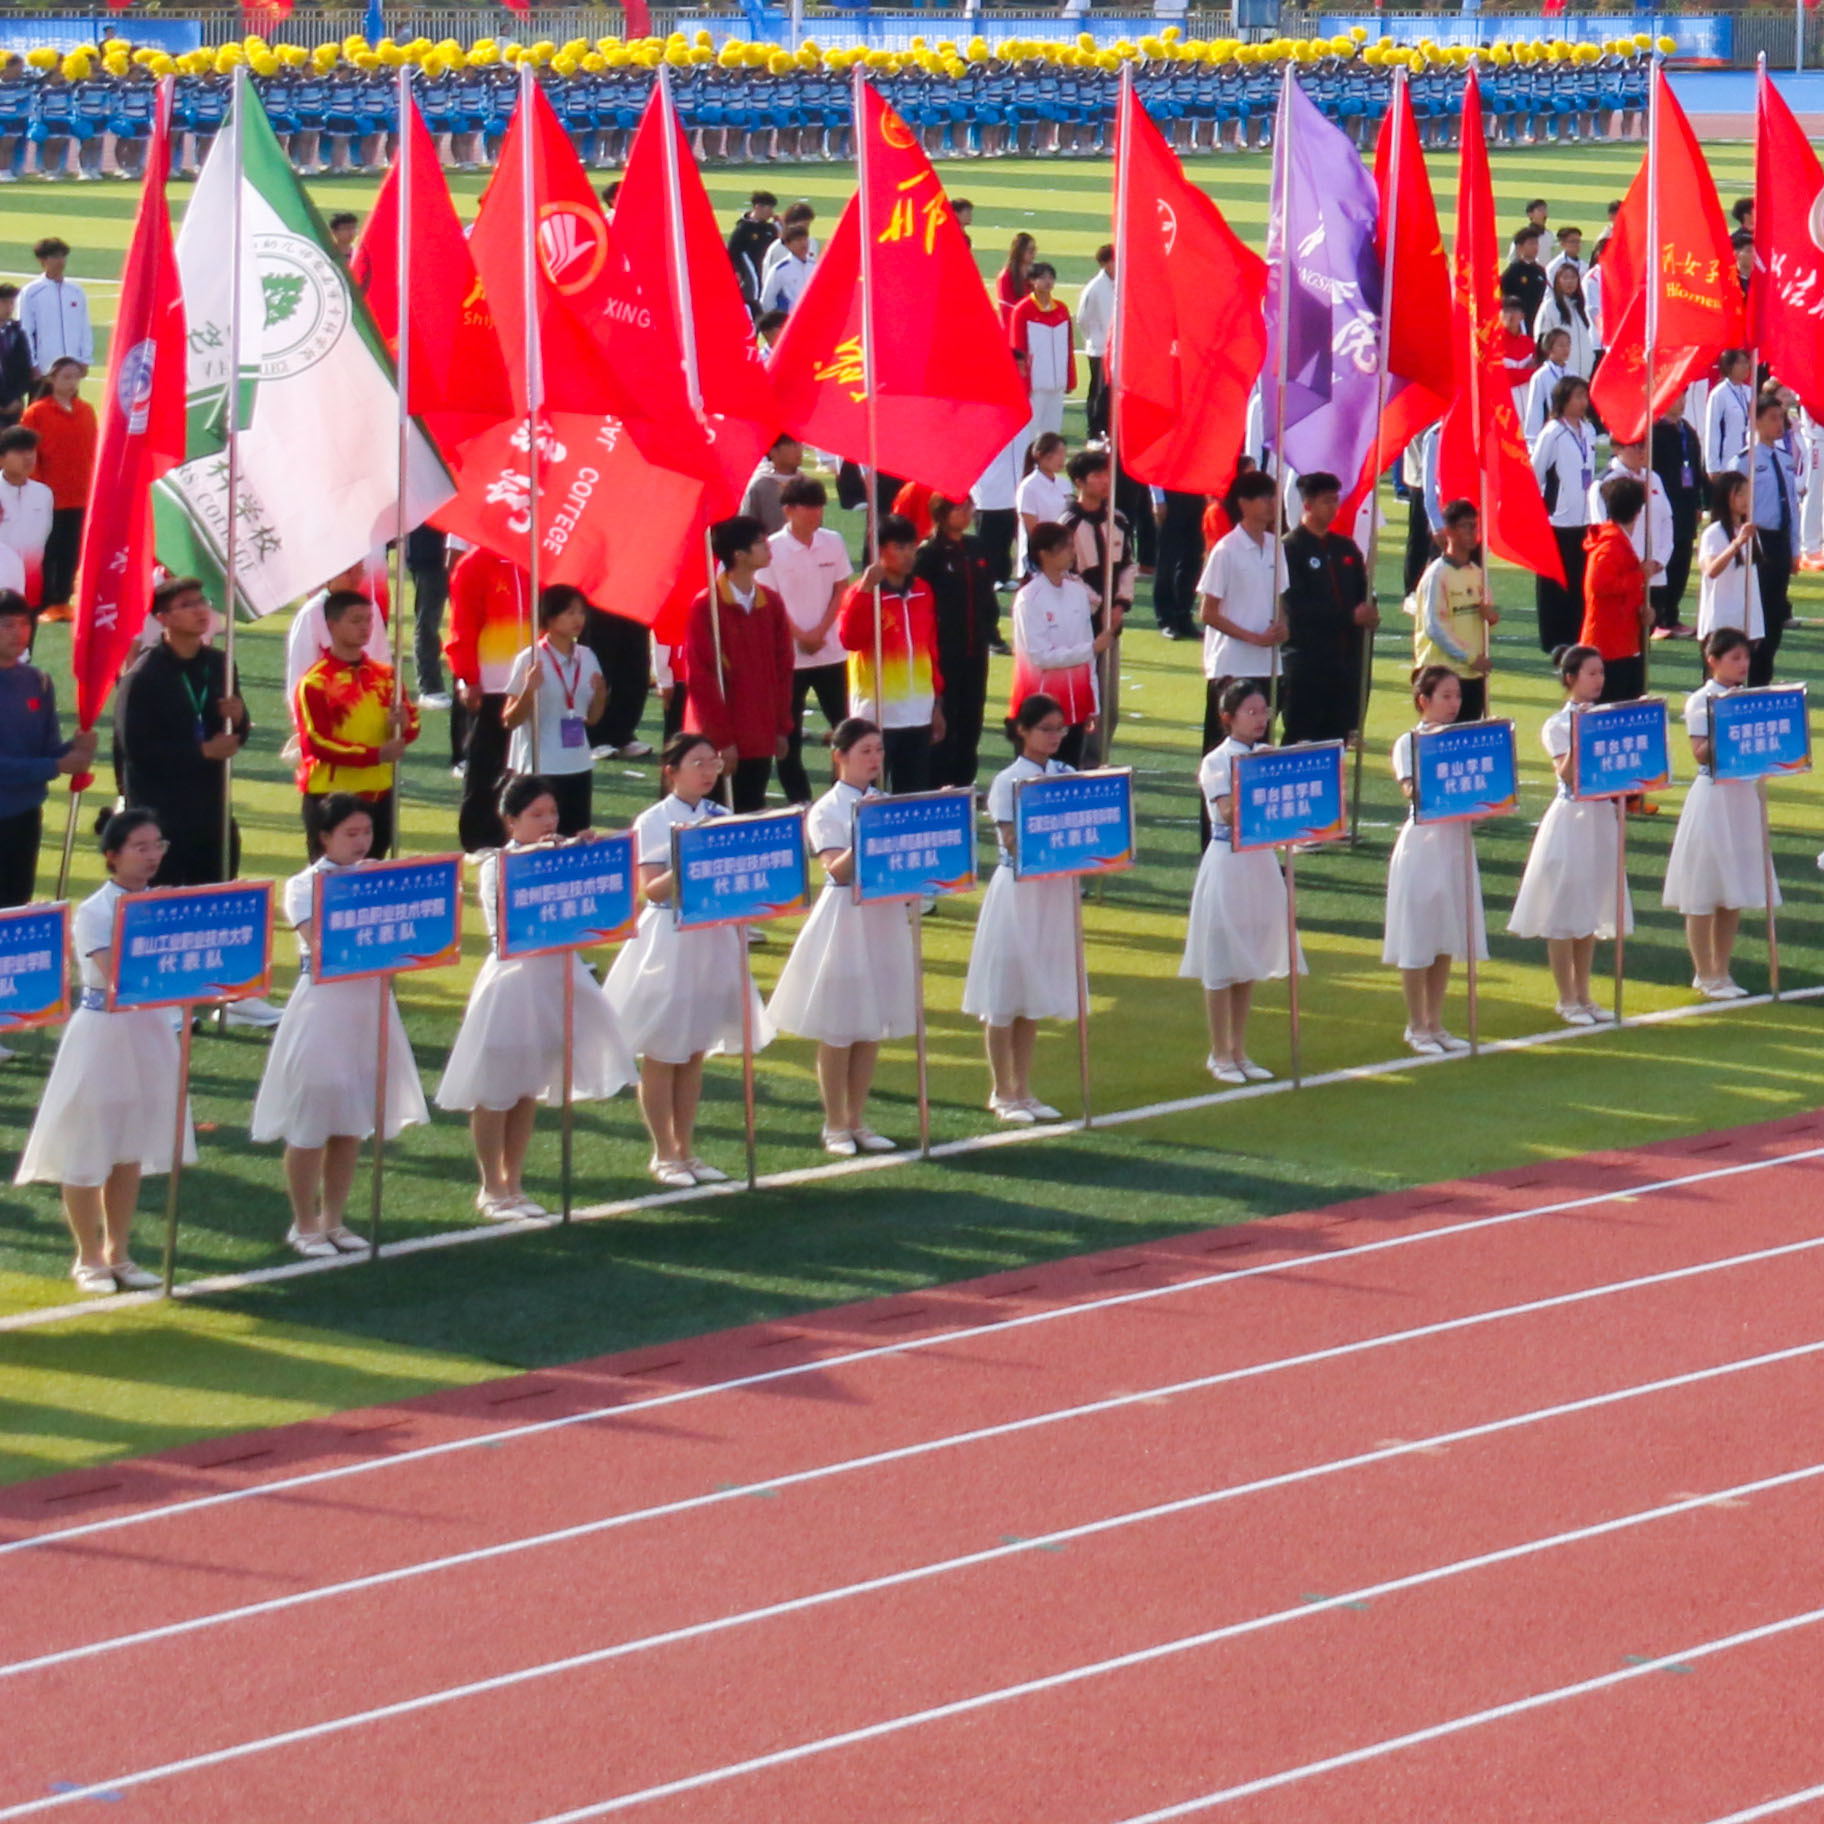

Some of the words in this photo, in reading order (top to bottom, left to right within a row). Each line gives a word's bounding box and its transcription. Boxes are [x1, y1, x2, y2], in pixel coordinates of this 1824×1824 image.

[1727, 718, 1792, 740] 石家庄学院
[1593, 734, 1649, 758] 邢台学院
[1739, 737, 1782, 755] 代表队
[1435, 755, 1494, 780] 唐山学院
[1600, 752, 1643, 772] 代表队
[1444, 775, 1488, 795] 代表队
[1264, 801, 1312, 821] 代表队
[1048, 825, 1100, 848] 代表队
[687, 849, 794, 881] 石家庄职业技术学院
[887, 847, 940, 870] 代表队
[514, 872, 624, 909] 沧州职业技术学院
[712, 868, 769, 895] 代表队
[329, 897, 447, 932] 秦皇岛职业技术学院
[539, 895, 598, 923] 代表队
[130, 925, 254, 958] 唐山工业职业技术大学
[355, 919, 417, 947] 代表队
[157, 948, 224, 974] 代表队
